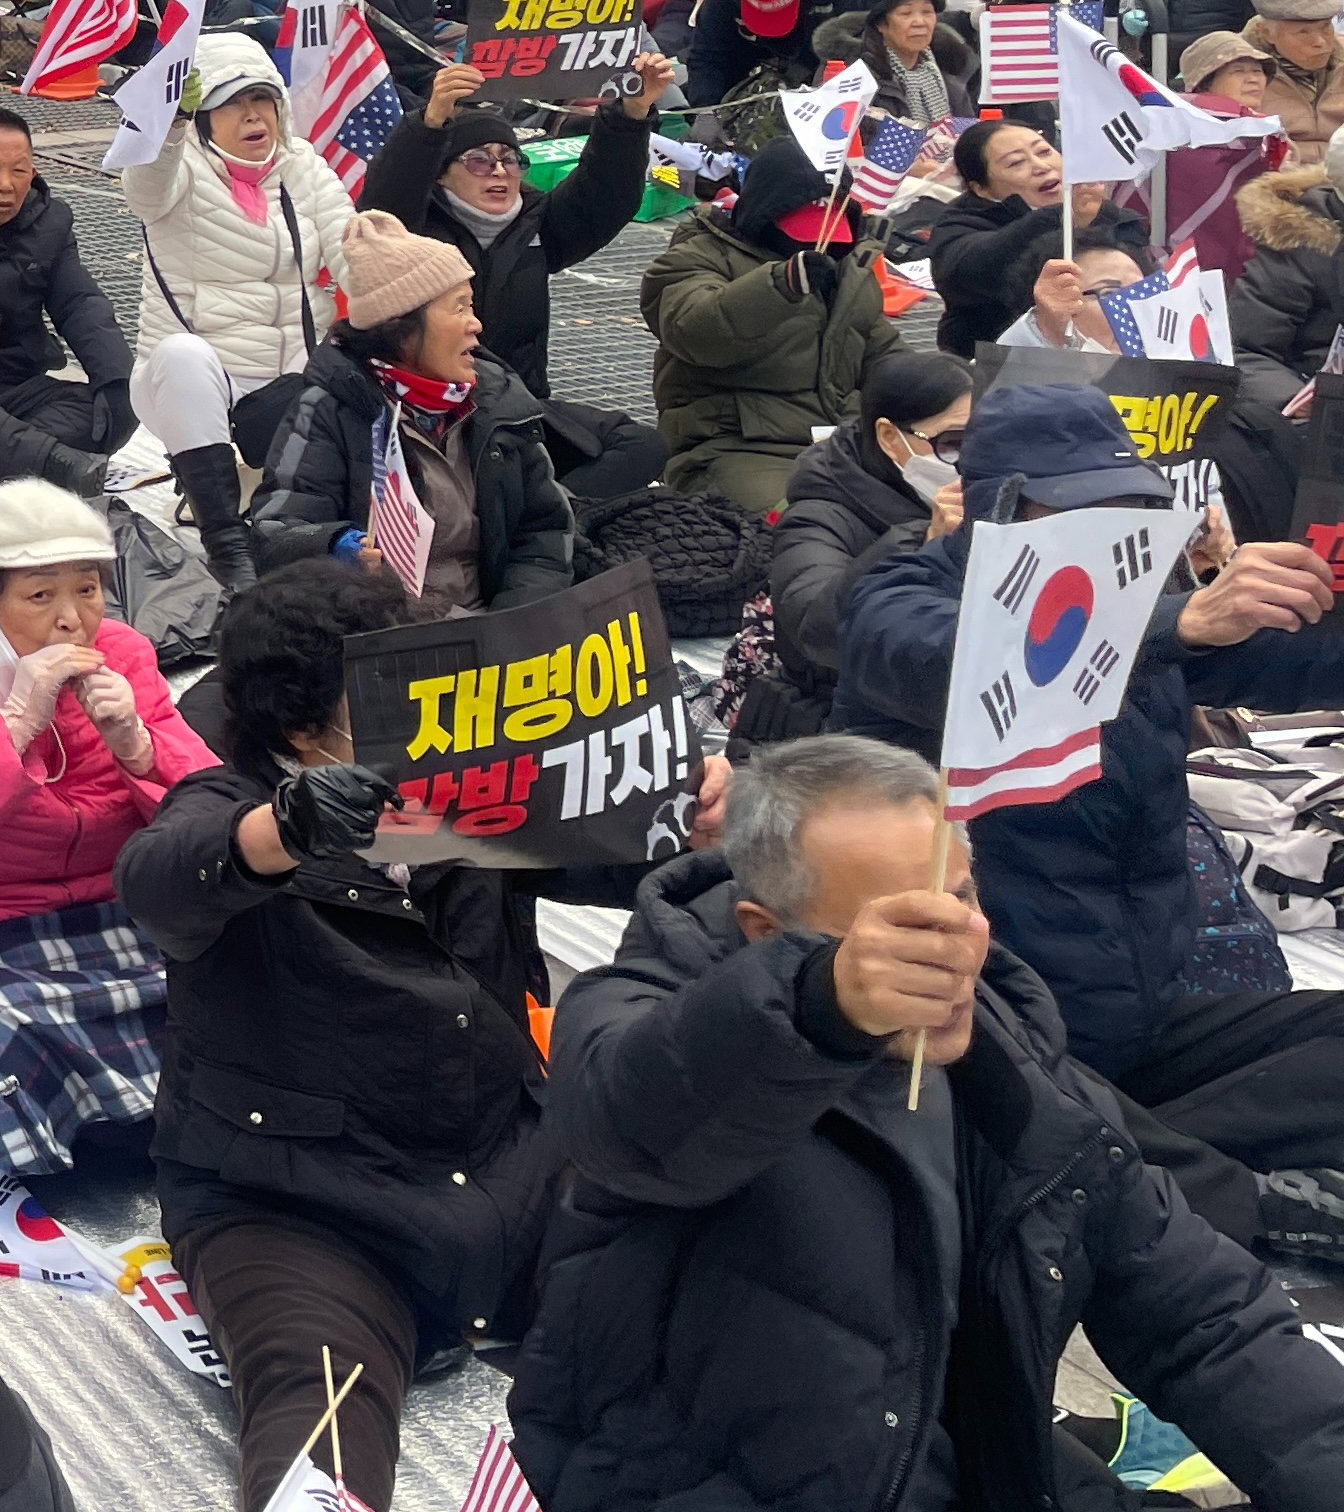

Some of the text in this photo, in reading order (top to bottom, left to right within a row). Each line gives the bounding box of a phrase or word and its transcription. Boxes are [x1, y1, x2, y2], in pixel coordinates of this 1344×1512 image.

[471, 24, 643, 80] 깜방 가자!
[1109, 392, 1220, 459] 명아!
[405, 610, 648, 762] 재명아!
[541, 694, 689, 821] 가자!
